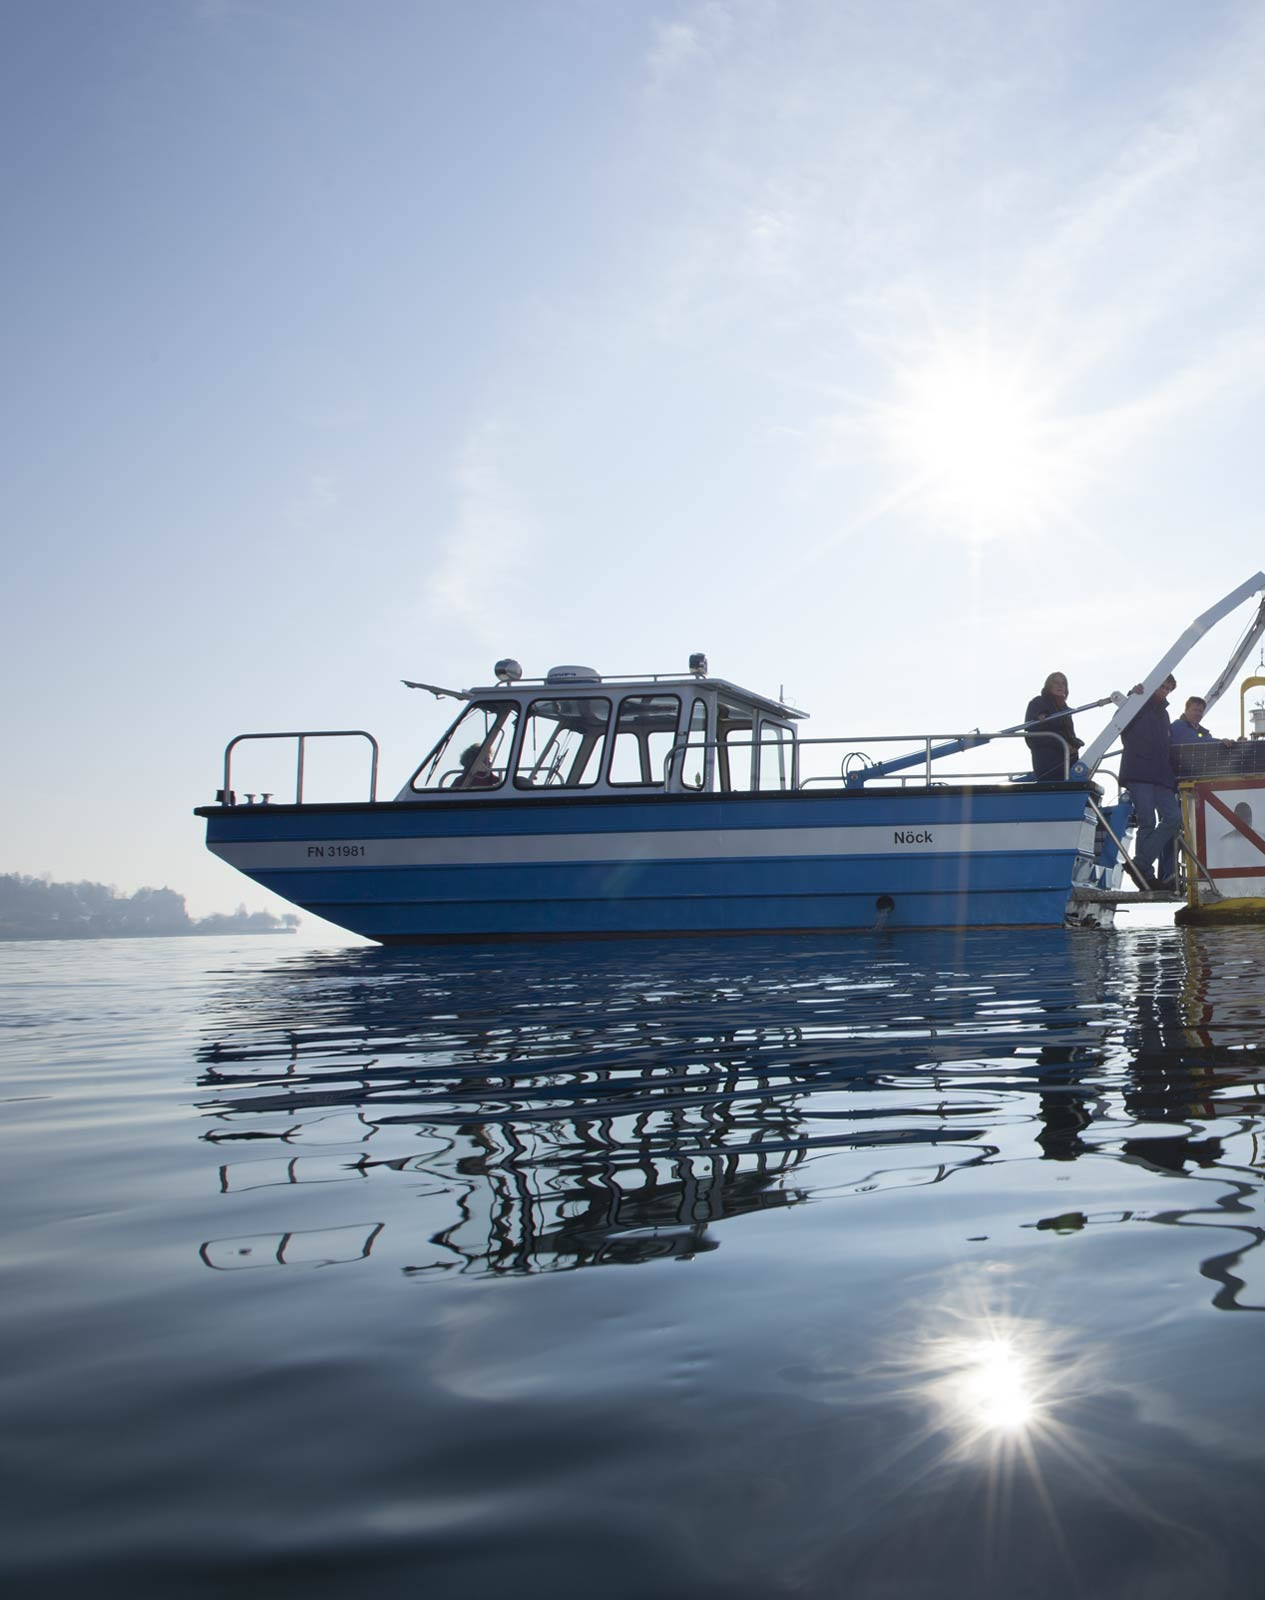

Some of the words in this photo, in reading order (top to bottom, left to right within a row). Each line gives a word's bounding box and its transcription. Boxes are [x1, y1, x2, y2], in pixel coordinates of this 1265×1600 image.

[894, 830, 933, 844] Nöck
[307, 846, 324, 857] FN
[328, 846, 365, 857] 31981
